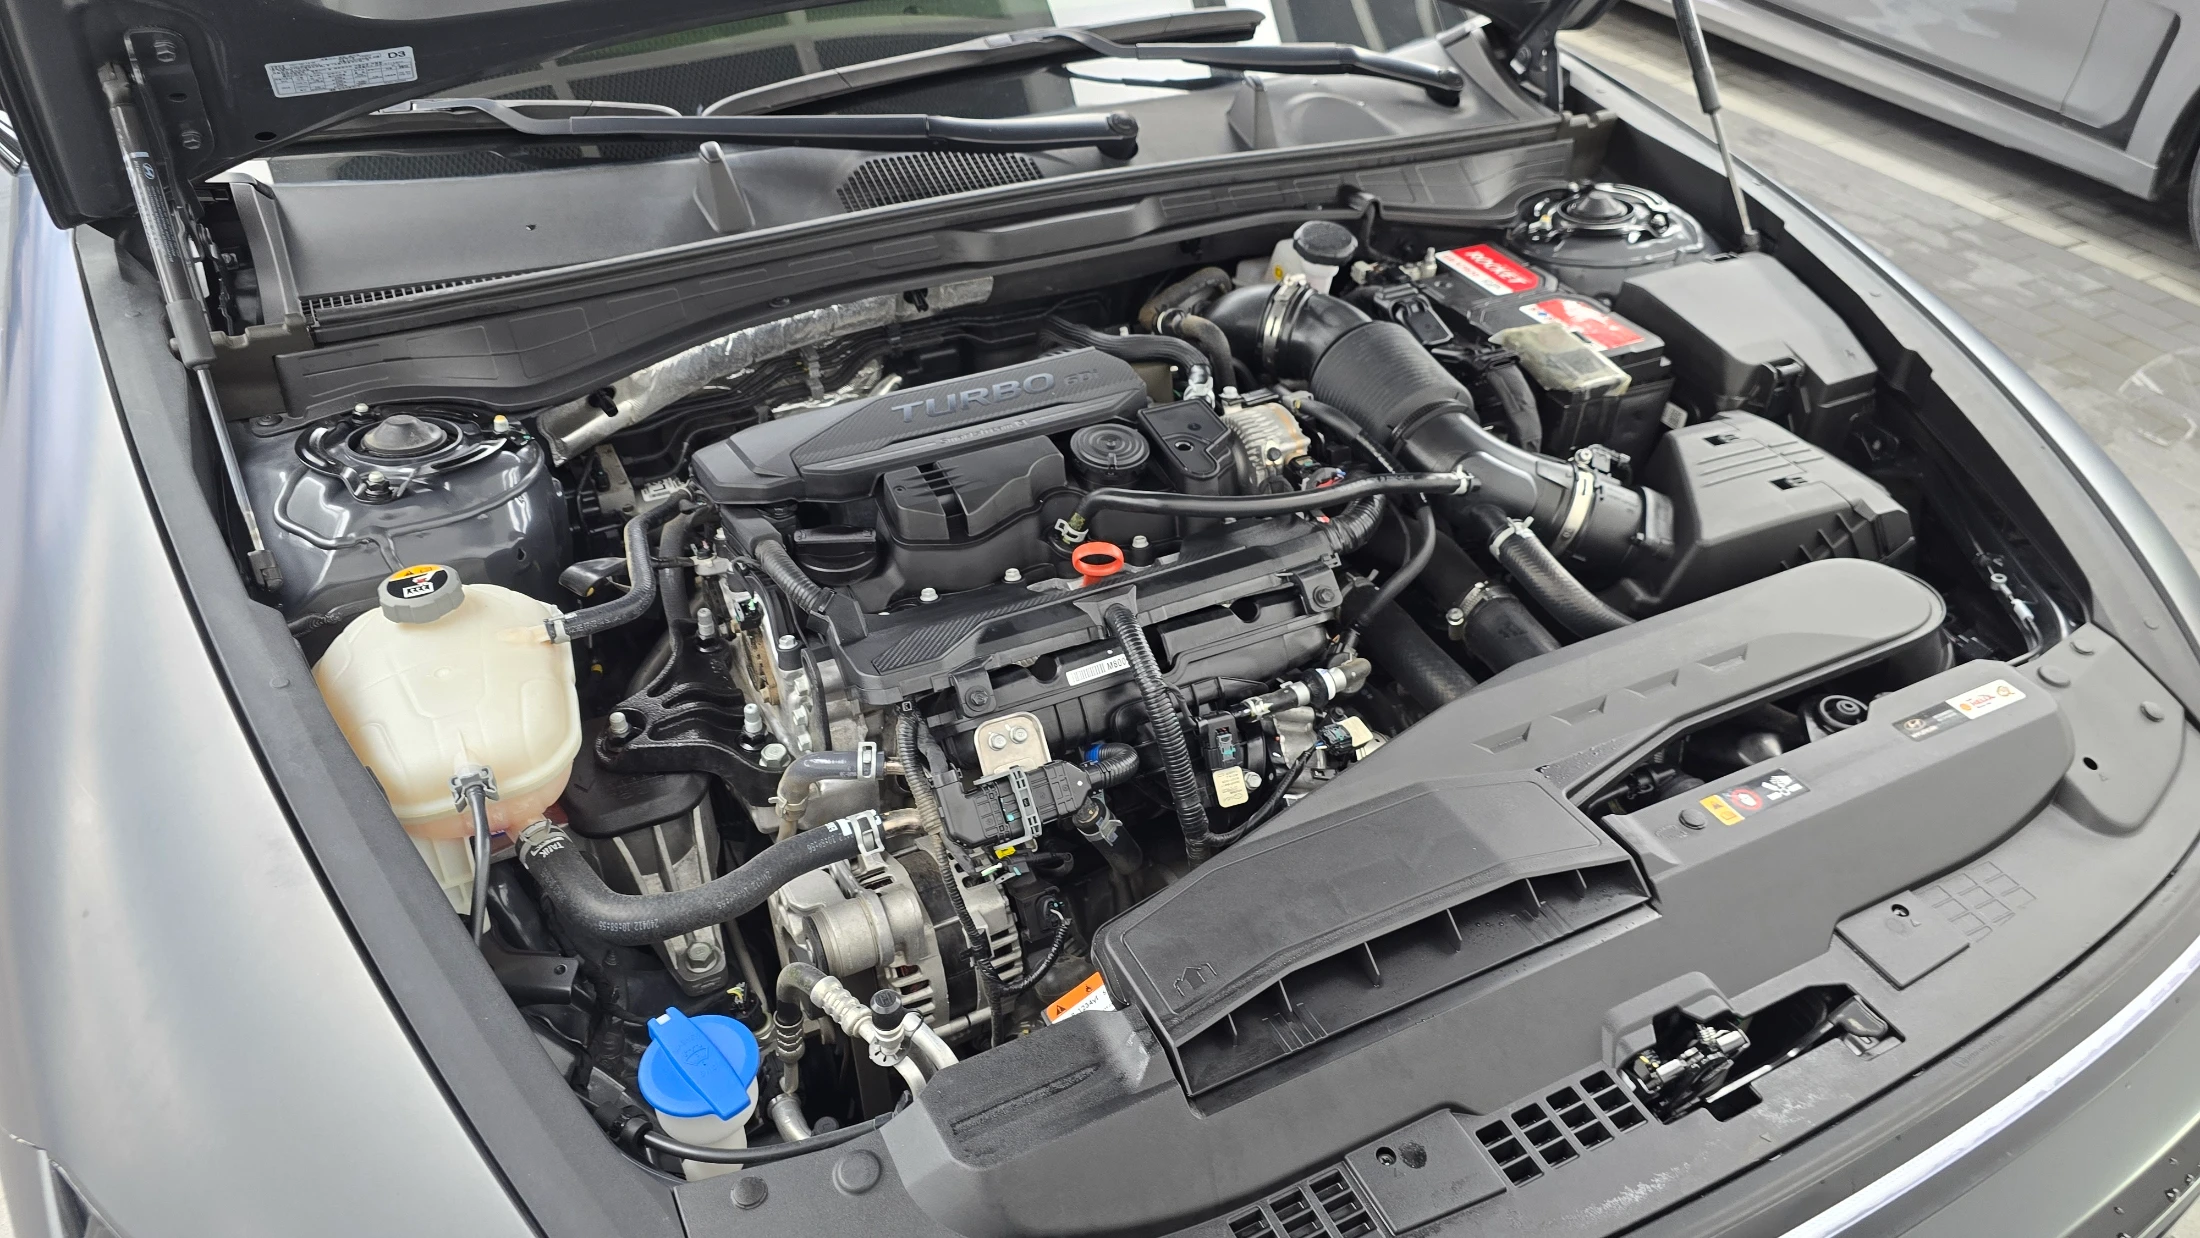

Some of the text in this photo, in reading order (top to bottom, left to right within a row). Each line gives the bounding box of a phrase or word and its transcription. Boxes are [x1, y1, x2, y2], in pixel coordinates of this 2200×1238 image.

[387, 50, 407, 60] D3
[1464, 250, 1528, 285] ROCKET
[891, 372, 1055, 424] TURBO
[539, 841, 565, 858] TANK
[633, 918, 659, 931] 240412
